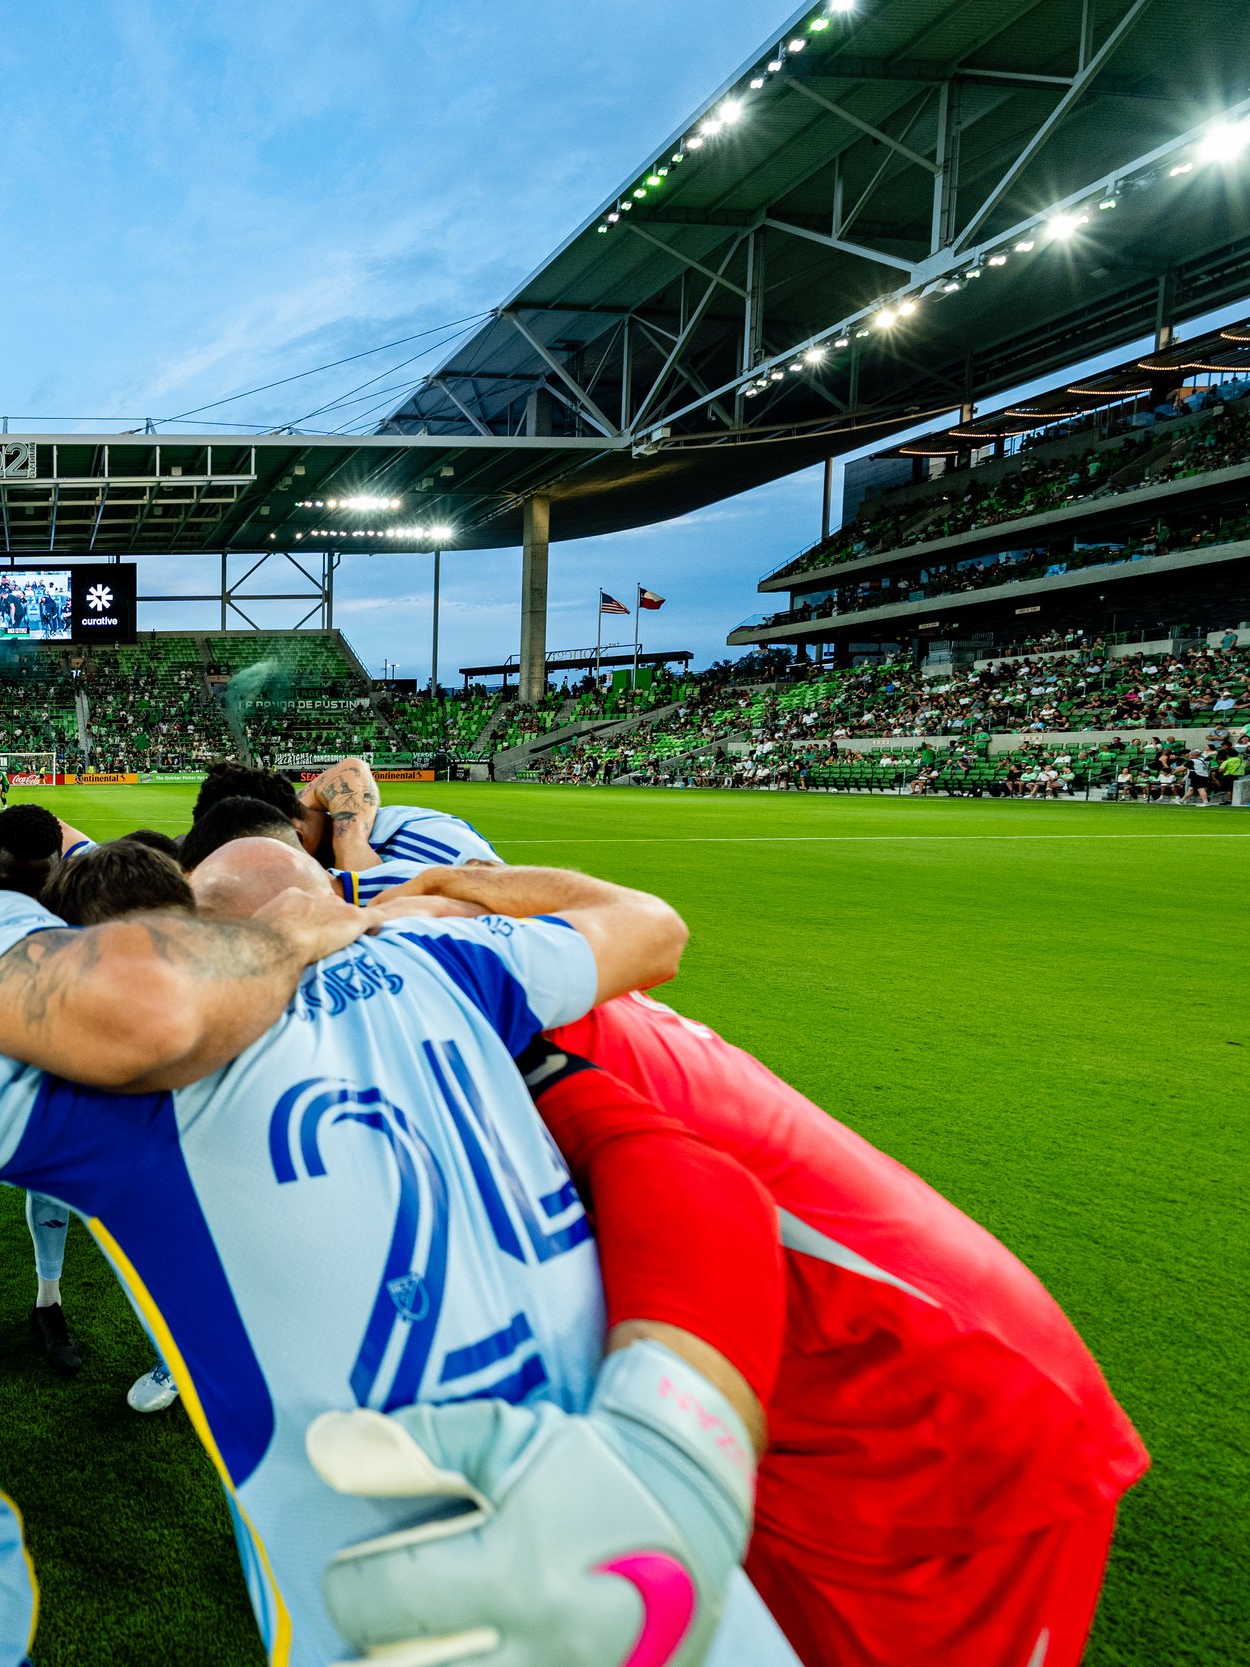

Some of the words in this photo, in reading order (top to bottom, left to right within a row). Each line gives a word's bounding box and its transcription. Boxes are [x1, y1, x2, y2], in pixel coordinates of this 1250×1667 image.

[28, 442, 37, 478] STADIUM
[81, 616, 118, 625] curative
[298, 700, 313, 709] DE
